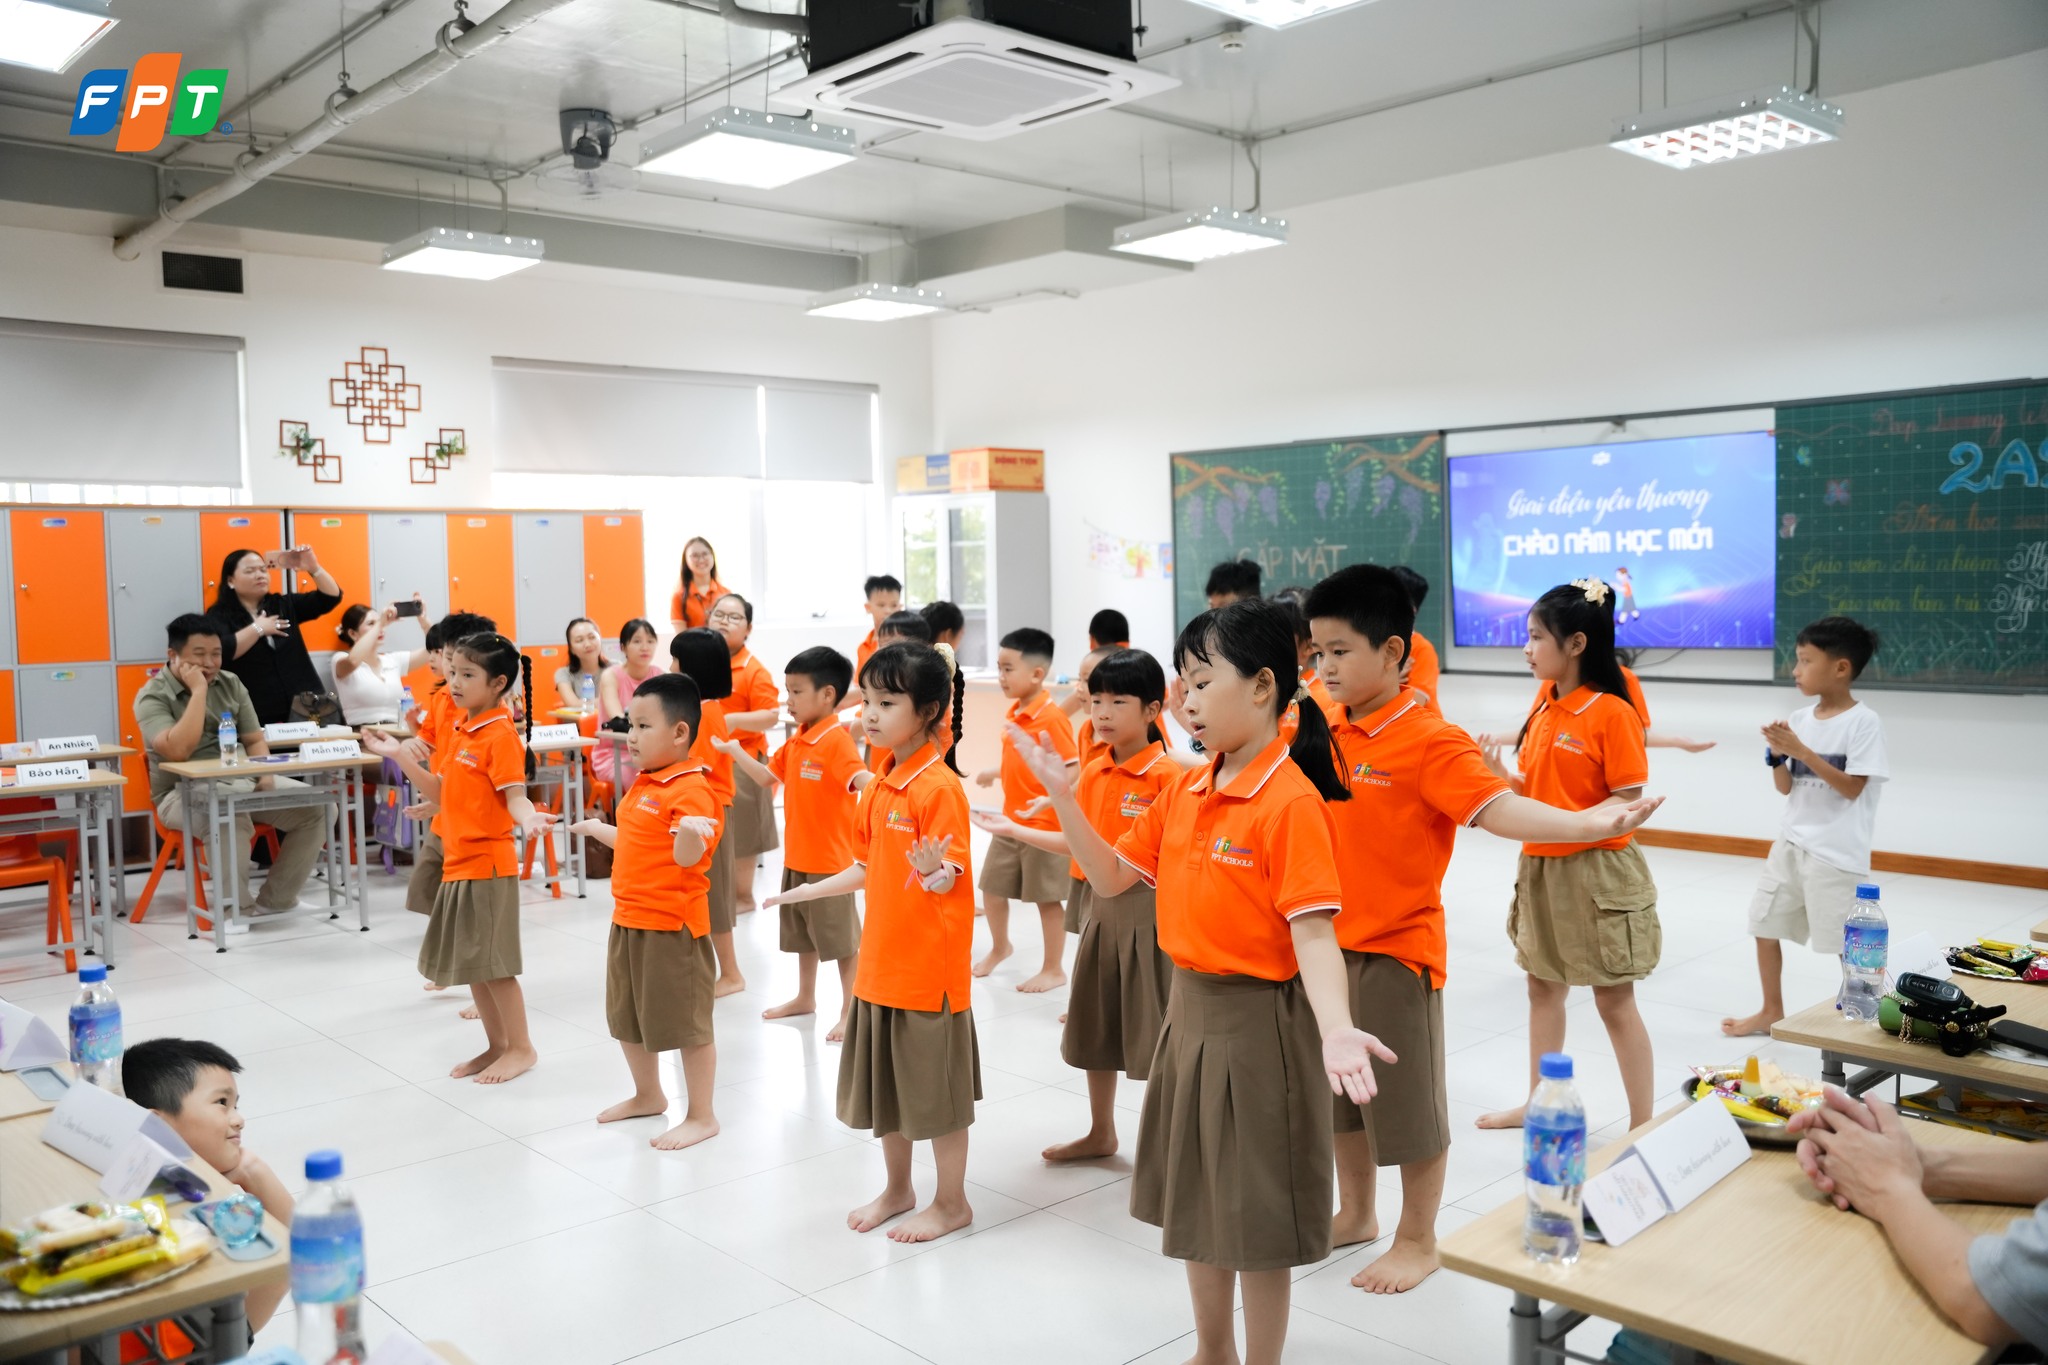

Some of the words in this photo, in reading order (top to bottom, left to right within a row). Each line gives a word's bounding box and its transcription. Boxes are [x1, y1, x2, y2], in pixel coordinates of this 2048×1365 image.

[1506, 489, 1544, 520] Giai
[1547, 485, 1591, 518] điệu
[1592, 486, 1632, 526] yêu
[1634, 479, 1712, 520] thương
[1503, 527, 1559, 557] CHÀO
[1564, 526, 1612, 555] NĂM
[1615, 528, 1663, 557] HỌC
[1668, 520, 1714, 551] MỚI
[63, 740, 93, 749] Nhiên
[28, 767, 52, 778] Bảo
[1222, 855, 1254, 868] SCHOOLS
